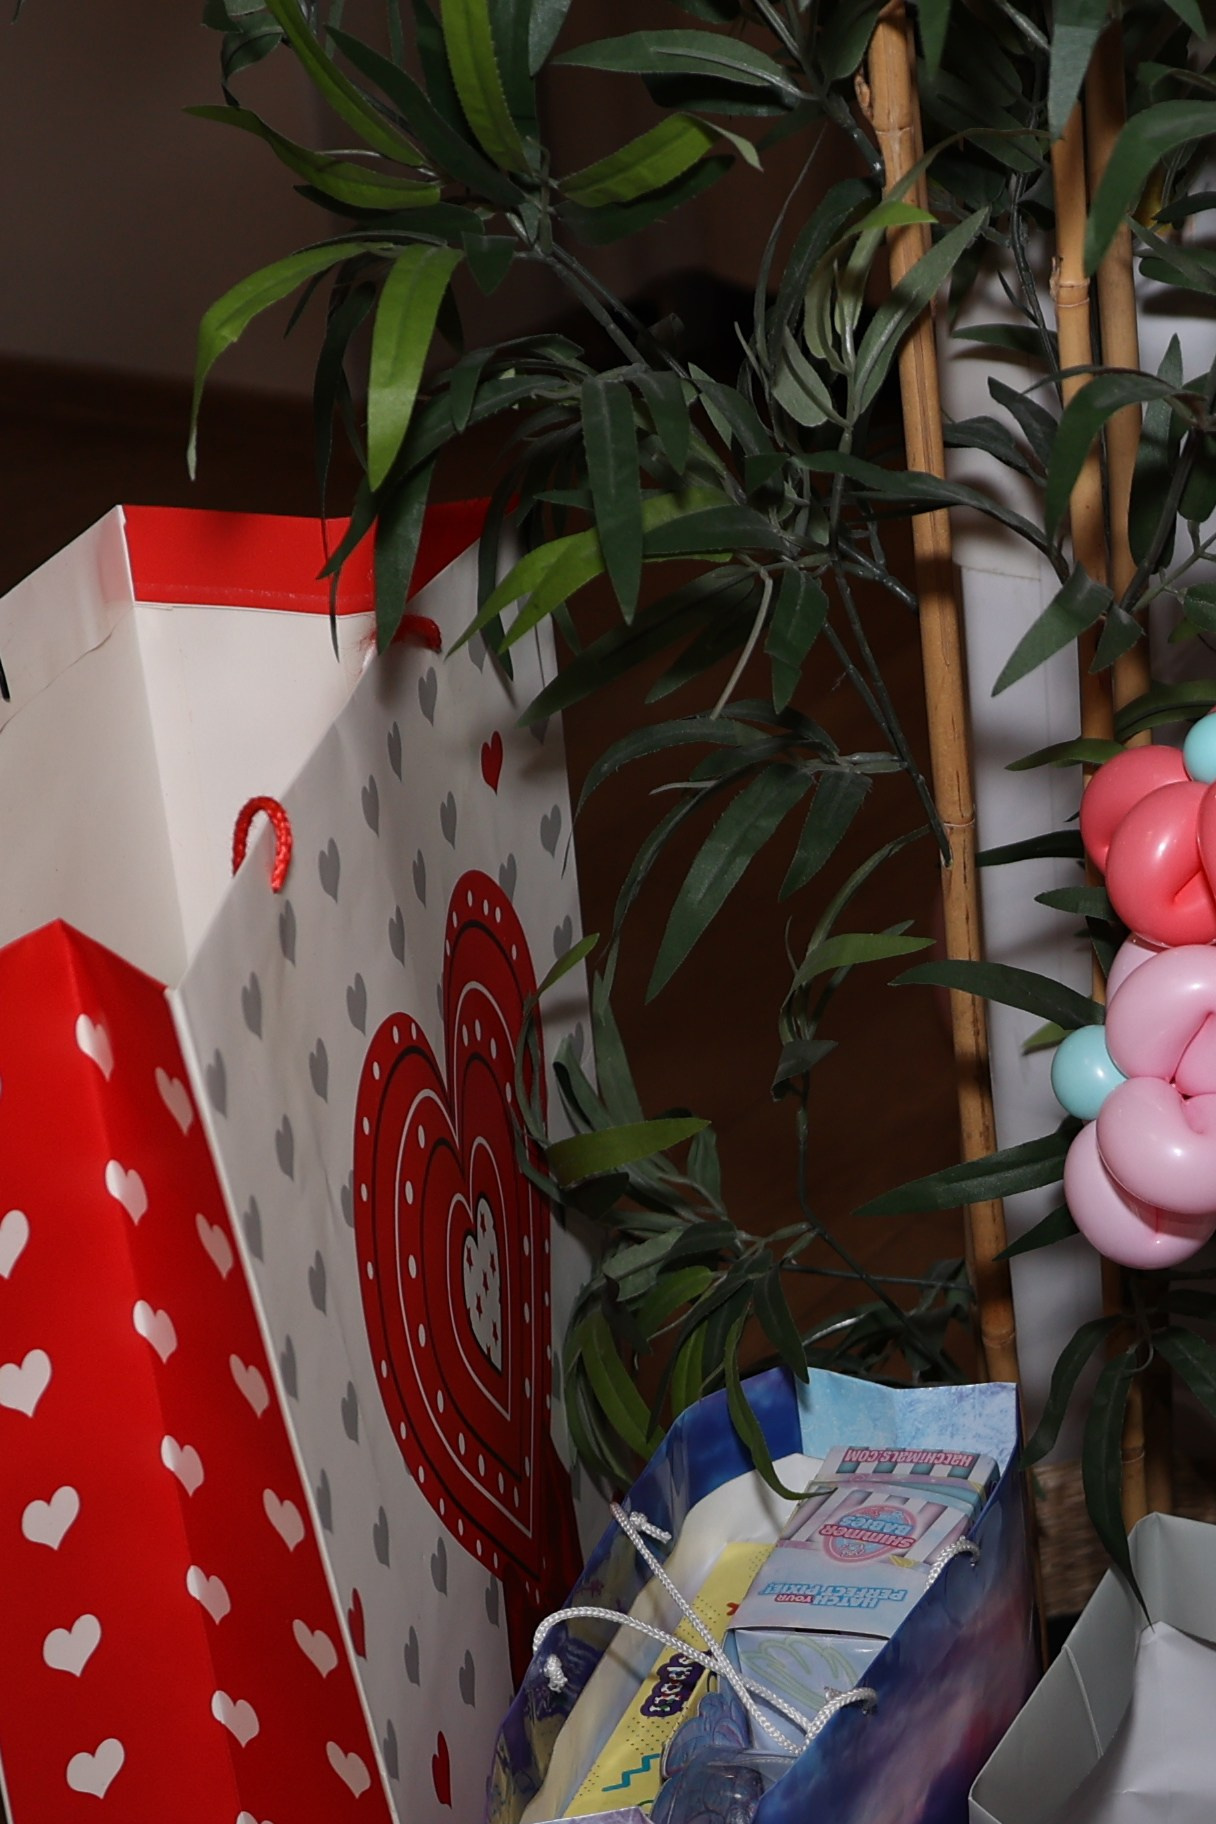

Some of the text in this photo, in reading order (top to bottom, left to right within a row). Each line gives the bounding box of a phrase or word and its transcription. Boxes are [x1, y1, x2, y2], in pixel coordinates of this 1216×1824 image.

[825, 1585, 907, 1601] PERFECT
[775, 1594, 879, 1608] HATCH YOUR
